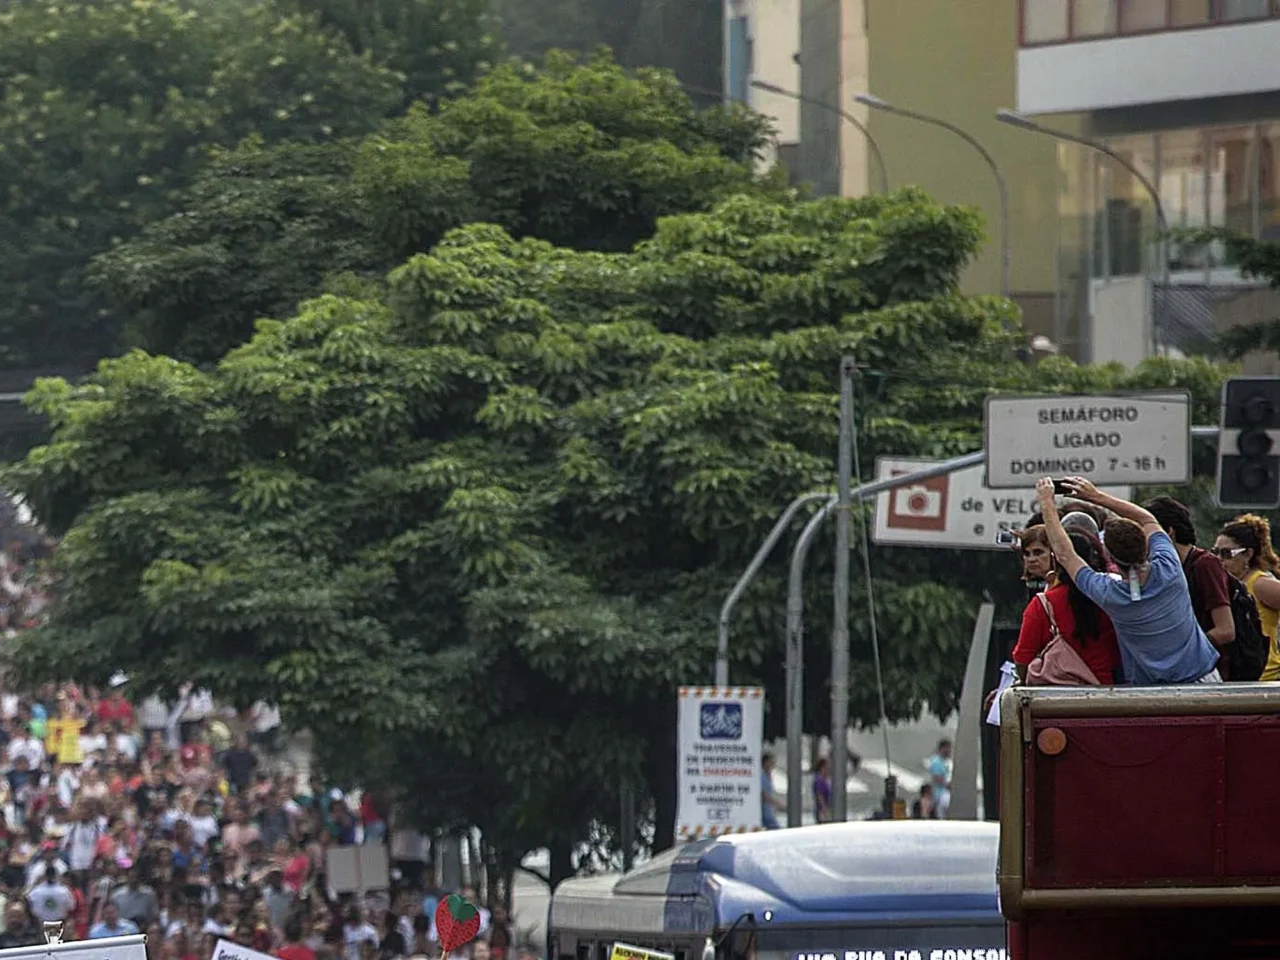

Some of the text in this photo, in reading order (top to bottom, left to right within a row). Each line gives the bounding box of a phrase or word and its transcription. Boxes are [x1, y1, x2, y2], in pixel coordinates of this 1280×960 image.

[1037, 404, 1139, 424] SEMÁFORO
[1053, 432, 1122, 449] LIGADO
[1010, 458, 1096, 474] DOMINGO
[1107, 457, 1118, 471] 7
[1134, 457, 1154, 471] 16
[1156, 456, 1166, 470] h
[960, 498, 984, 514] de
